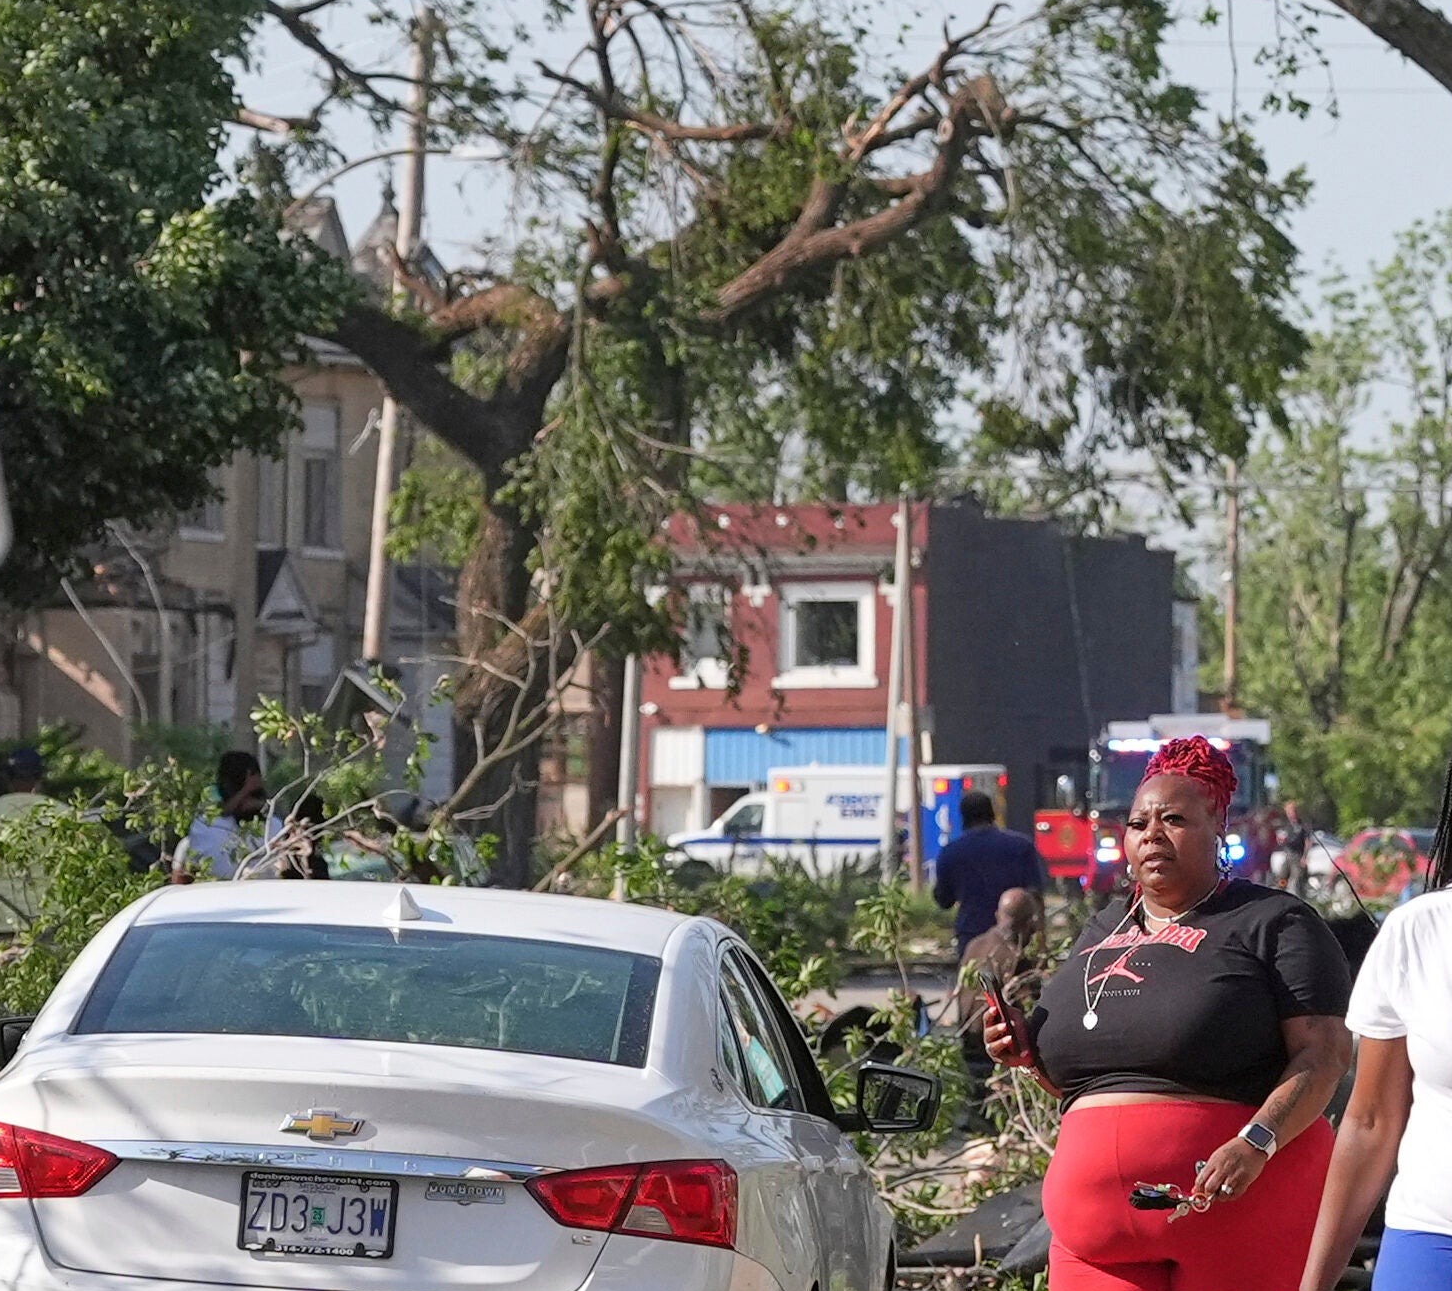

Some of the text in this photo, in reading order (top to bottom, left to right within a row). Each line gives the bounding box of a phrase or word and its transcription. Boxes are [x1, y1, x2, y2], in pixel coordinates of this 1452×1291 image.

[249, 1172, 392, 1187] donbrownchevrolet.com
[247, 1191, 388, 1238] ZD3 J3W
[274, 1244, 355, 1256] 314-772-1400
